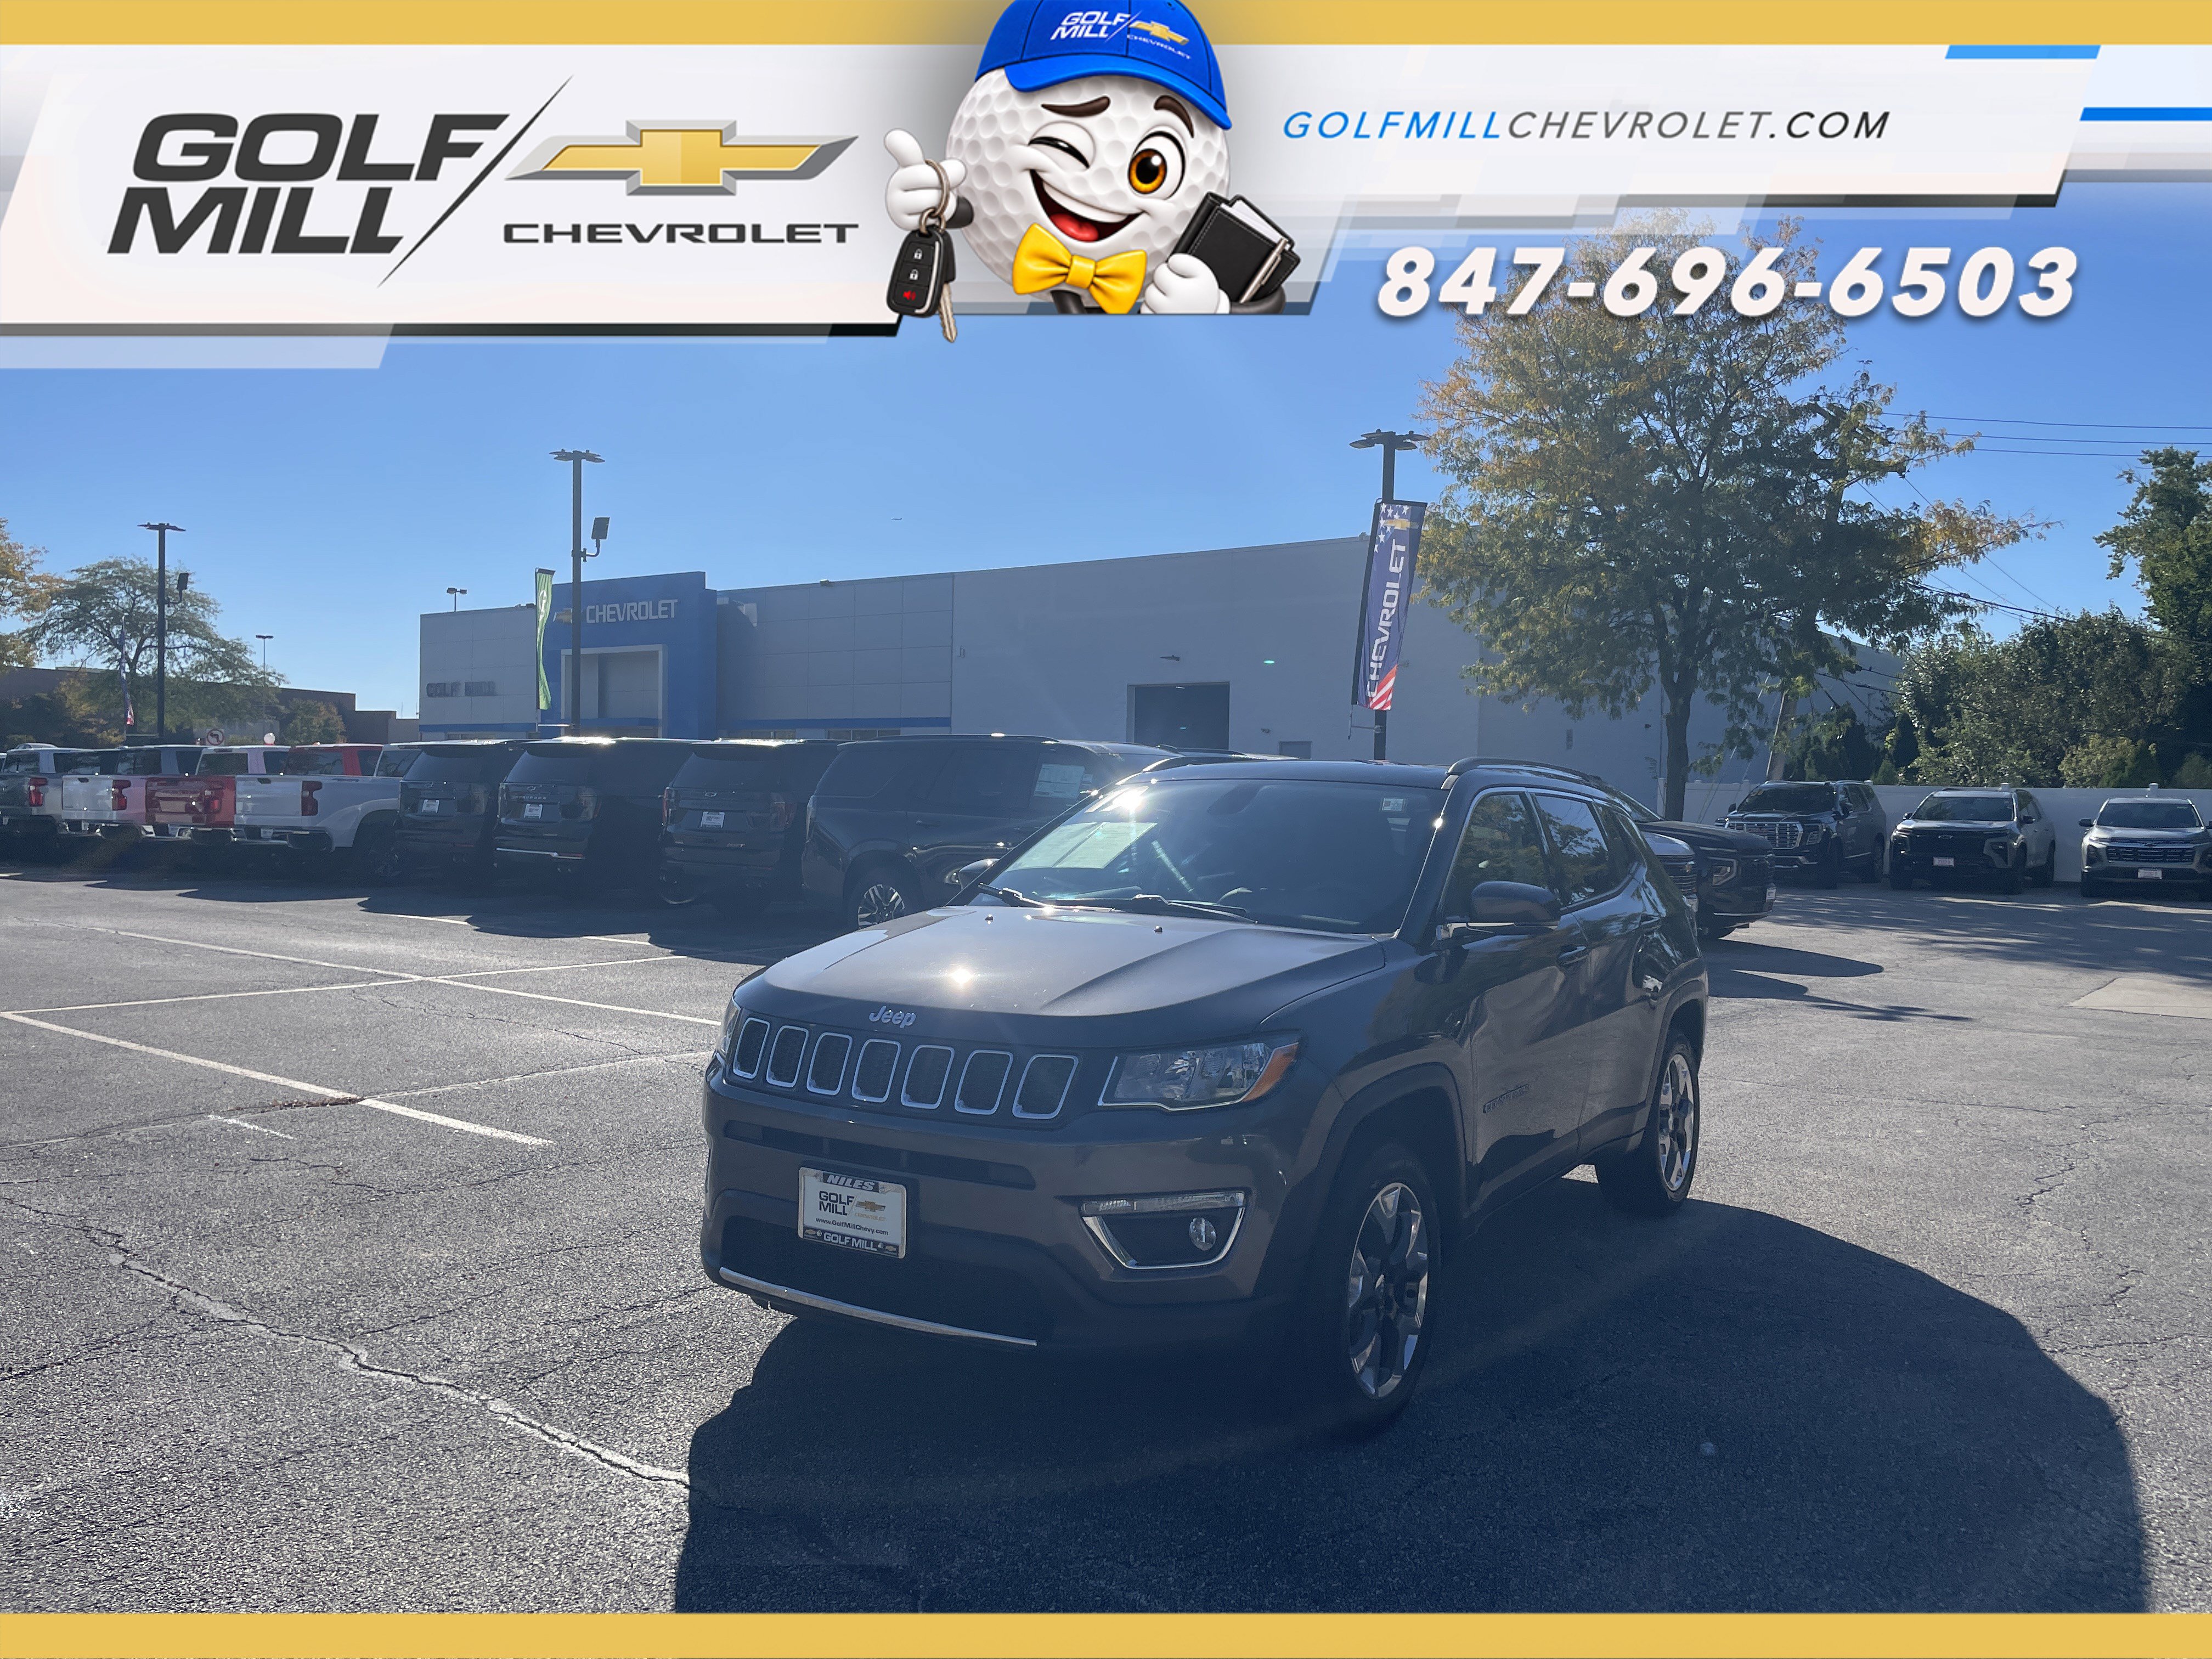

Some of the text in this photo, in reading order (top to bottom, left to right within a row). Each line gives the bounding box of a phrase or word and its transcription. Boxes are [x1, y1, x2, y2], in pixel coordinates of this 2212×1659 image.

[586, 599, 678, 624] CHEVROLET
[1367, 539, 1406, 698] CHEVROLET
[868, 1005, 916, 1029] Jeep
[826, 1175, 875, 1190] NILES
[819, 1190, 855, 1206] GOLF
[819, 1201, 848, 1216] MILL
[816, 1217, 889, 1235] www.GolfMillChevy.com
[823, 1232, 877, 1251] GOLF MILL
